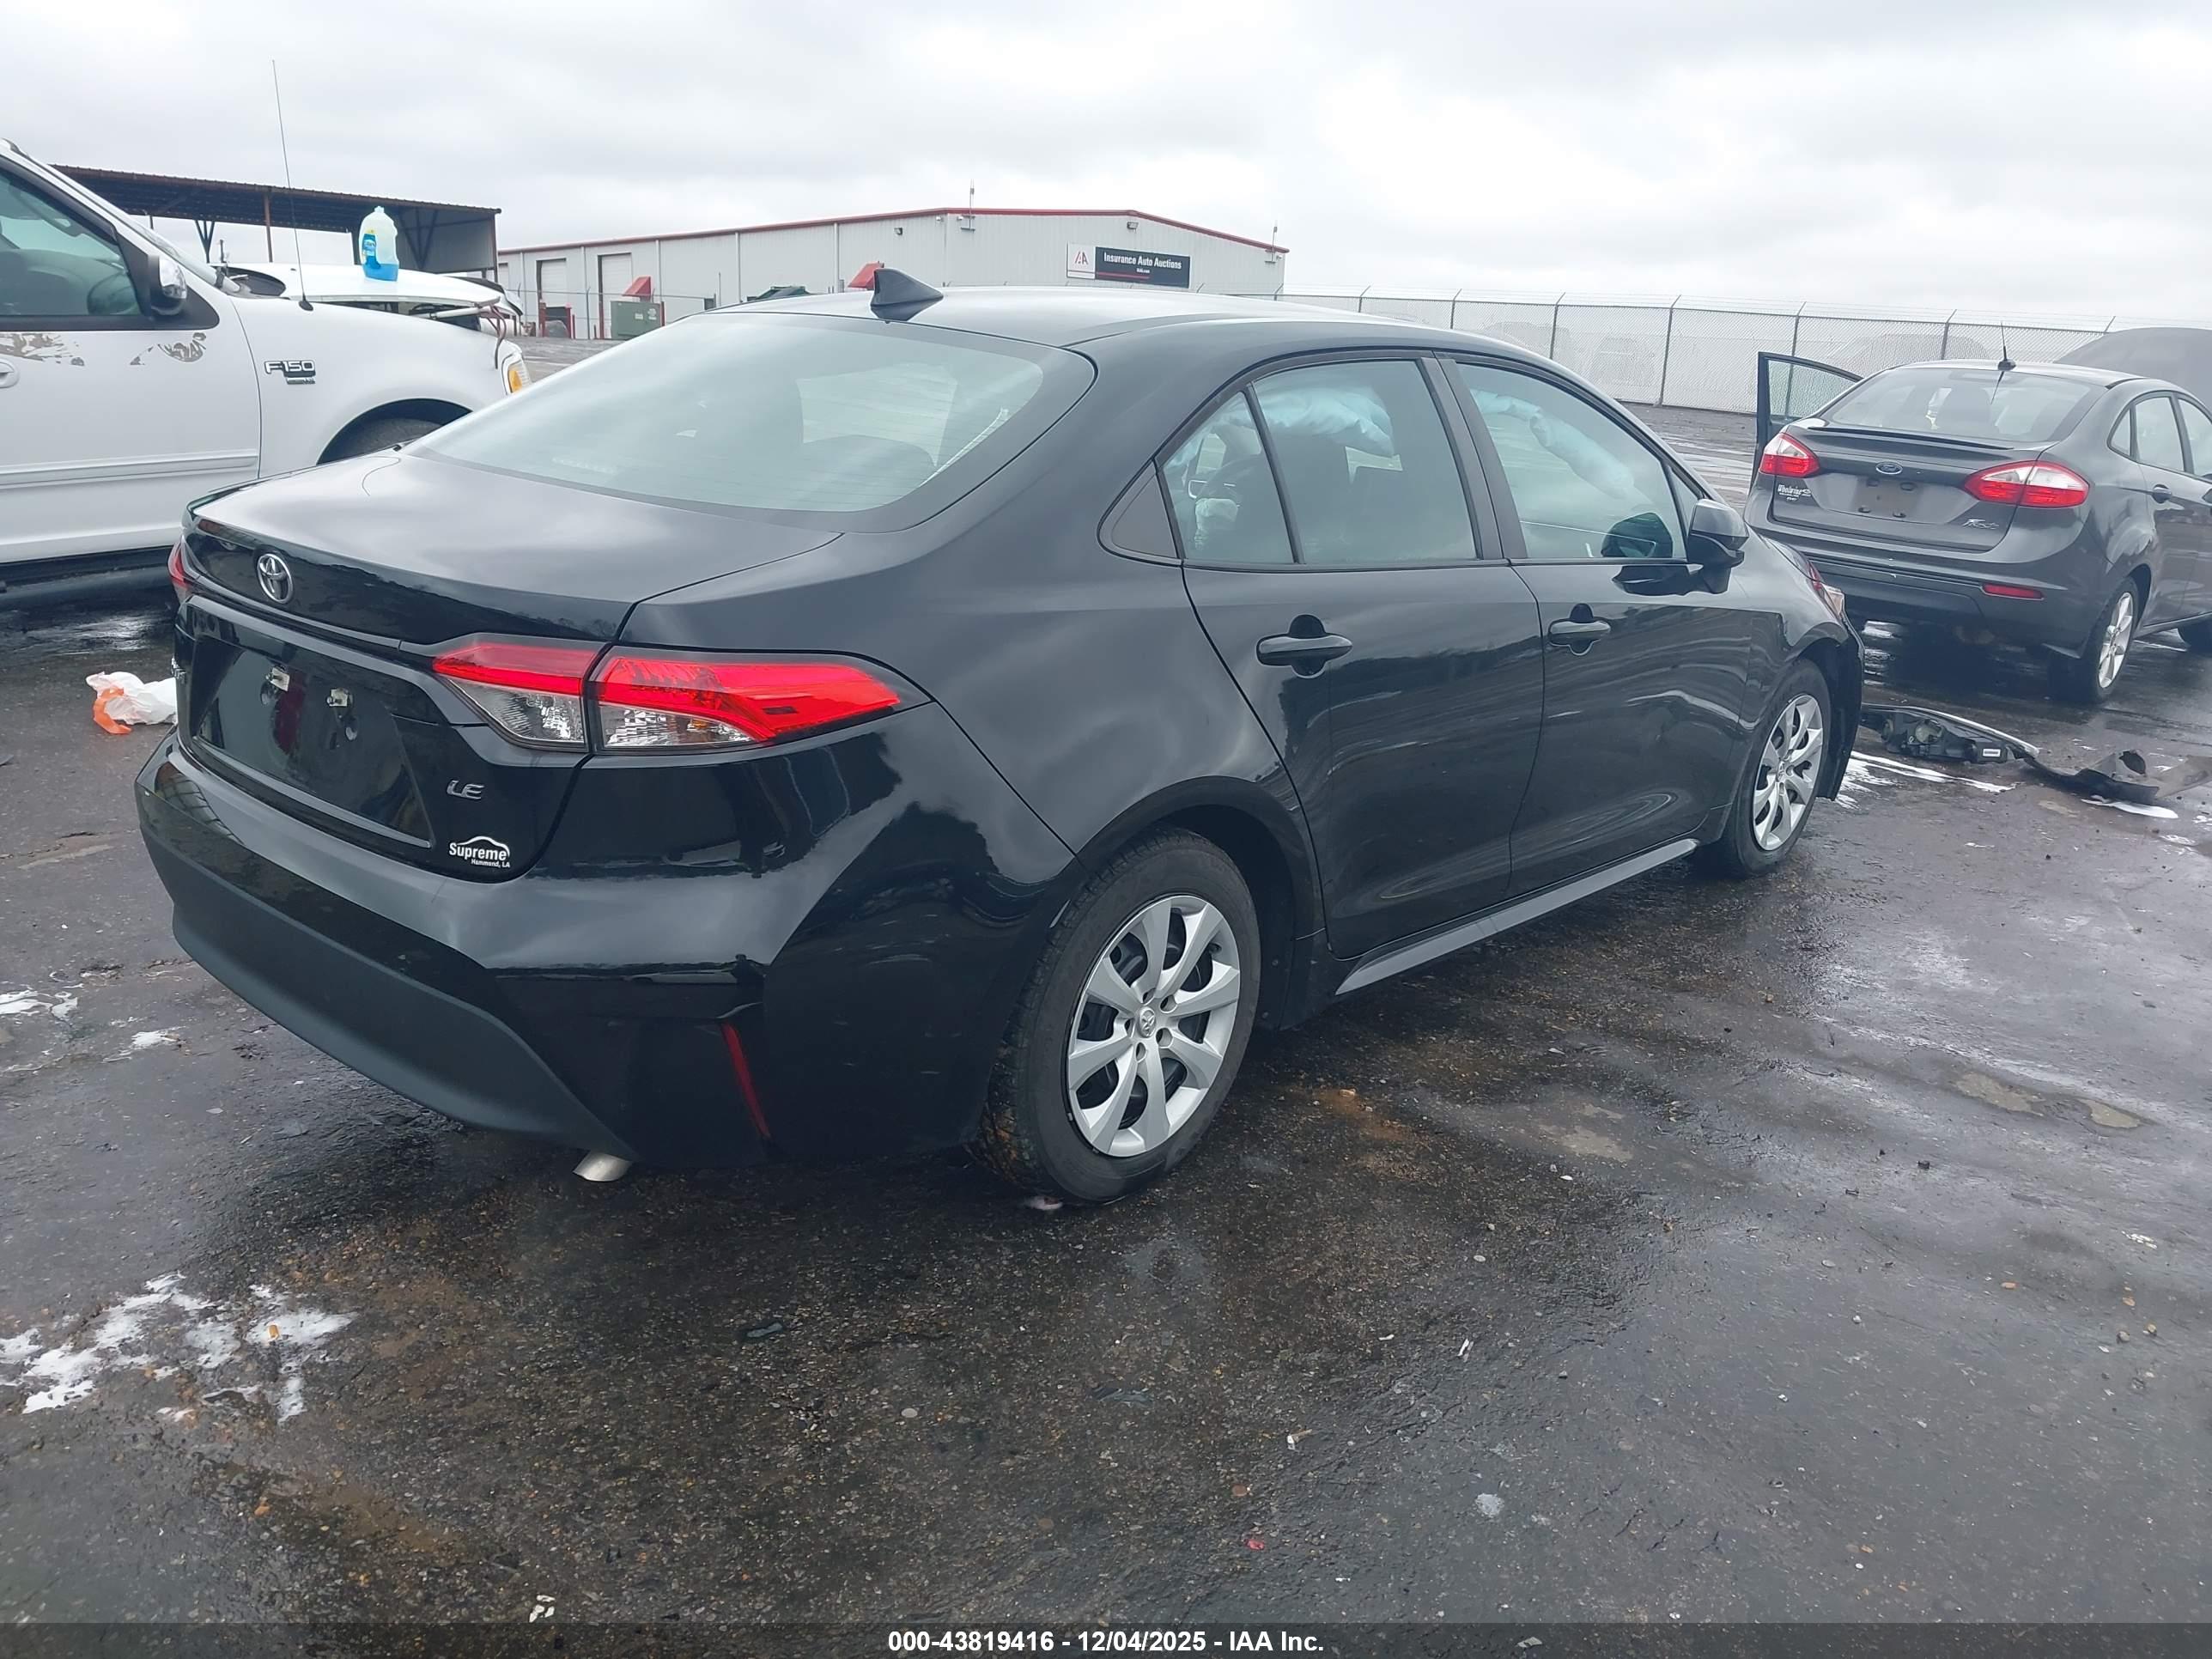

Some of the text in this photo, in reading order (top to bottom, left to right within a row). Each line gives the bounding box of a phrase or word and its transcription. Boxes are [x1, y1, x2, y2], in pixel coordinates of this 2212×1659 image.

[1103, 252, 1182, 270] Insurance Auto Auctions
[447, 780, 484, 799] LE
[449, 842, 507, 861] Supreme
[471, 859, 501, 868] Hammond,
